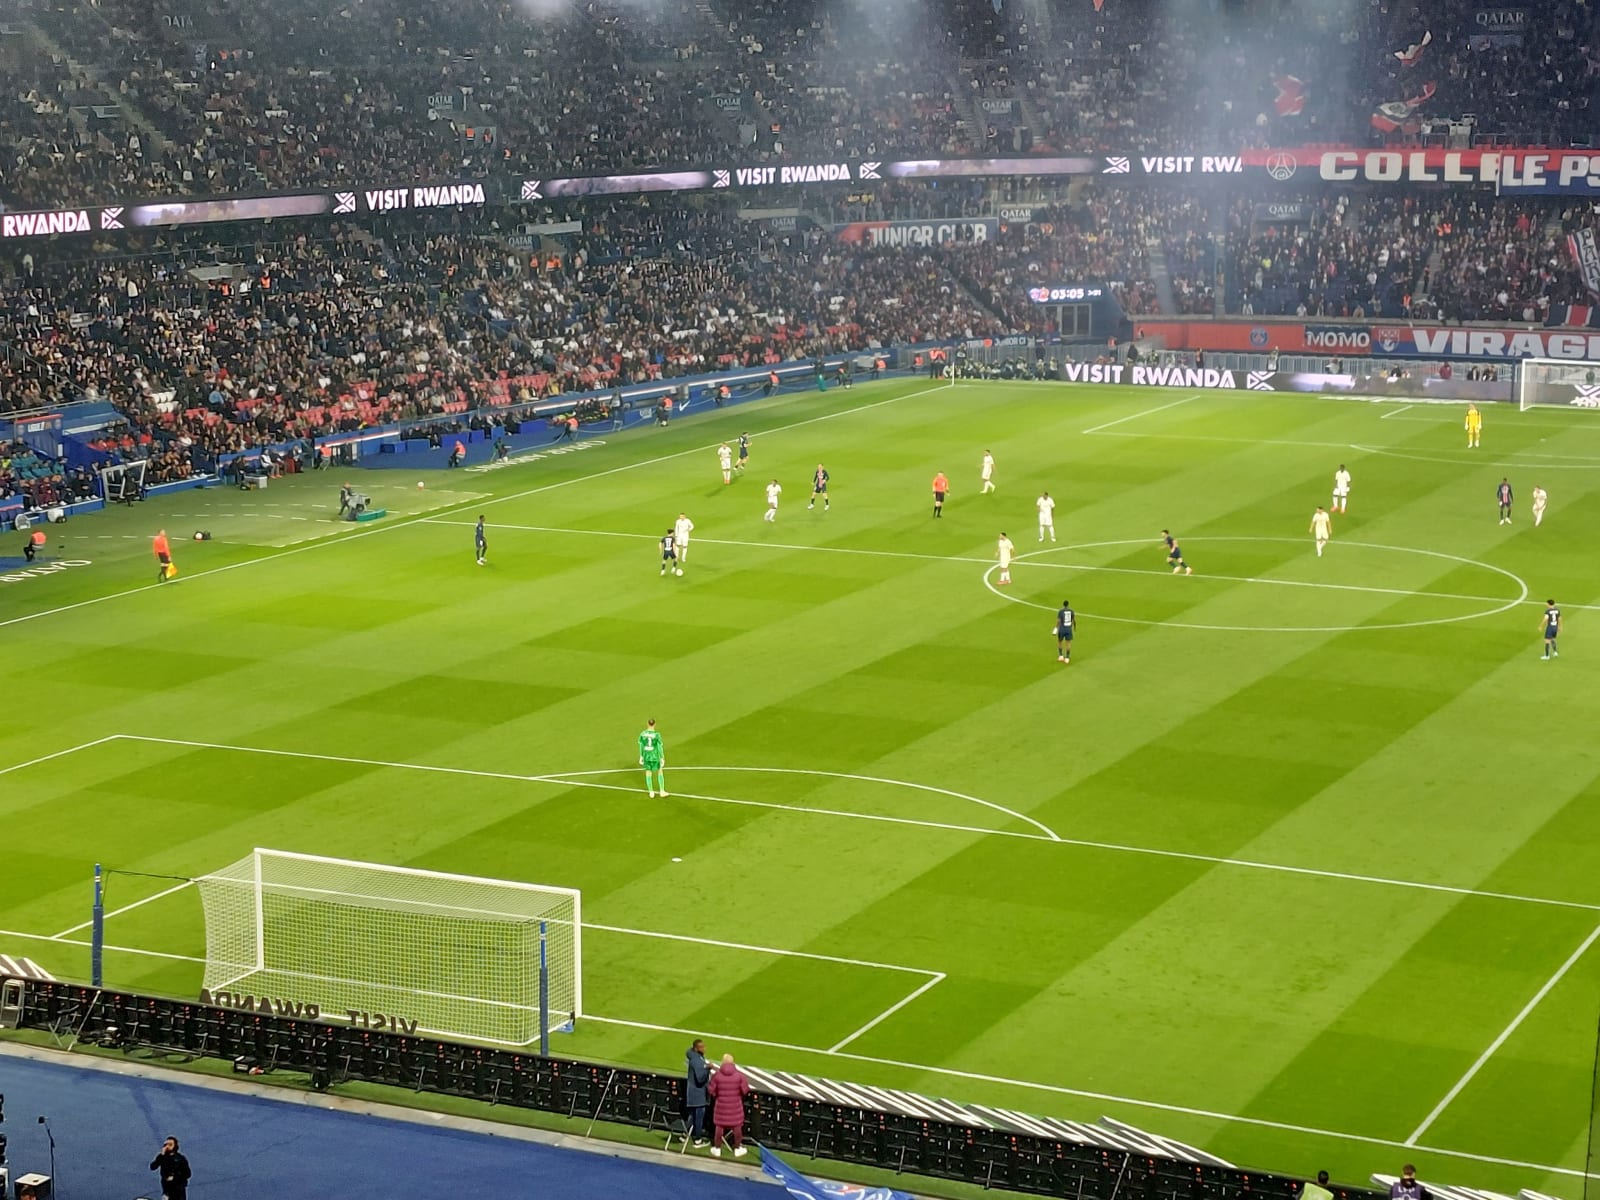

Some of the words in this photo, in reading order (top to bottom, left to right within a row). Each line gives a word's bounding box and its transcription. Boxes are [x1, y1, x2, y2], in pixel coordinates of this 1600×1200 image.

[1475, 11, 1524, 26] QATAR
[736, 167, 776, 186] VISIT
[780, 163, 851, 184] RWANDA
[1141, 156, 1195, 173] VISIT
[1502, 155, 1550, 187] LE
[365, 188, 409, 212] VISIT
[413, 183, 486, 208] RWANDA
[3, 210, 92, 237] RWANDA
[1000, 208, 1032, 219] QATAR
[1305, 331, 1370, 348] MOMO
[1065, 363, 1124, 384] VISIT
[1132, 366, 1236, 389] RWANDA
